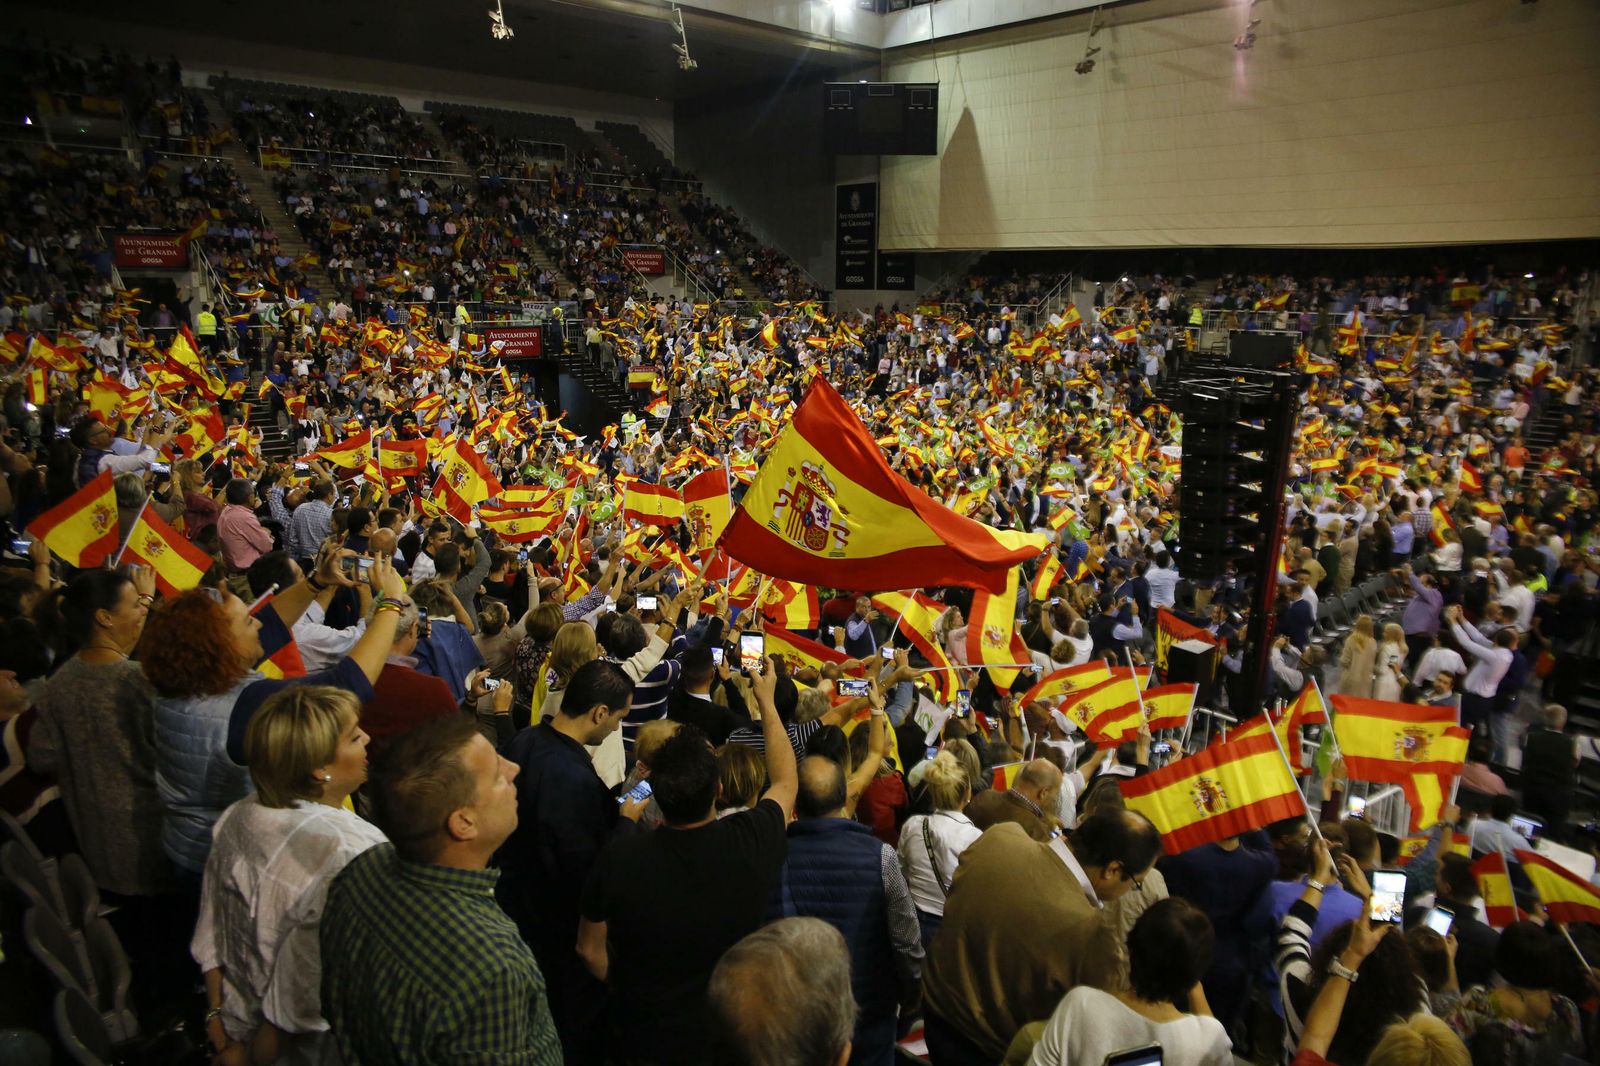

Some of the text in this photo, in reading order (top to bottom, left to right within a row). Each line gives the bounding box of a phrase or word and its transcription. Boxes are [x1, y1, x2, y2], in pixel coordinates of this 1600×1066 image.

[125, 247, 177, 256] DE GRANADA
[489, 331, 538, 339] AYUNTAMIENTO
[503, 339, 534, 347] GRANADA
